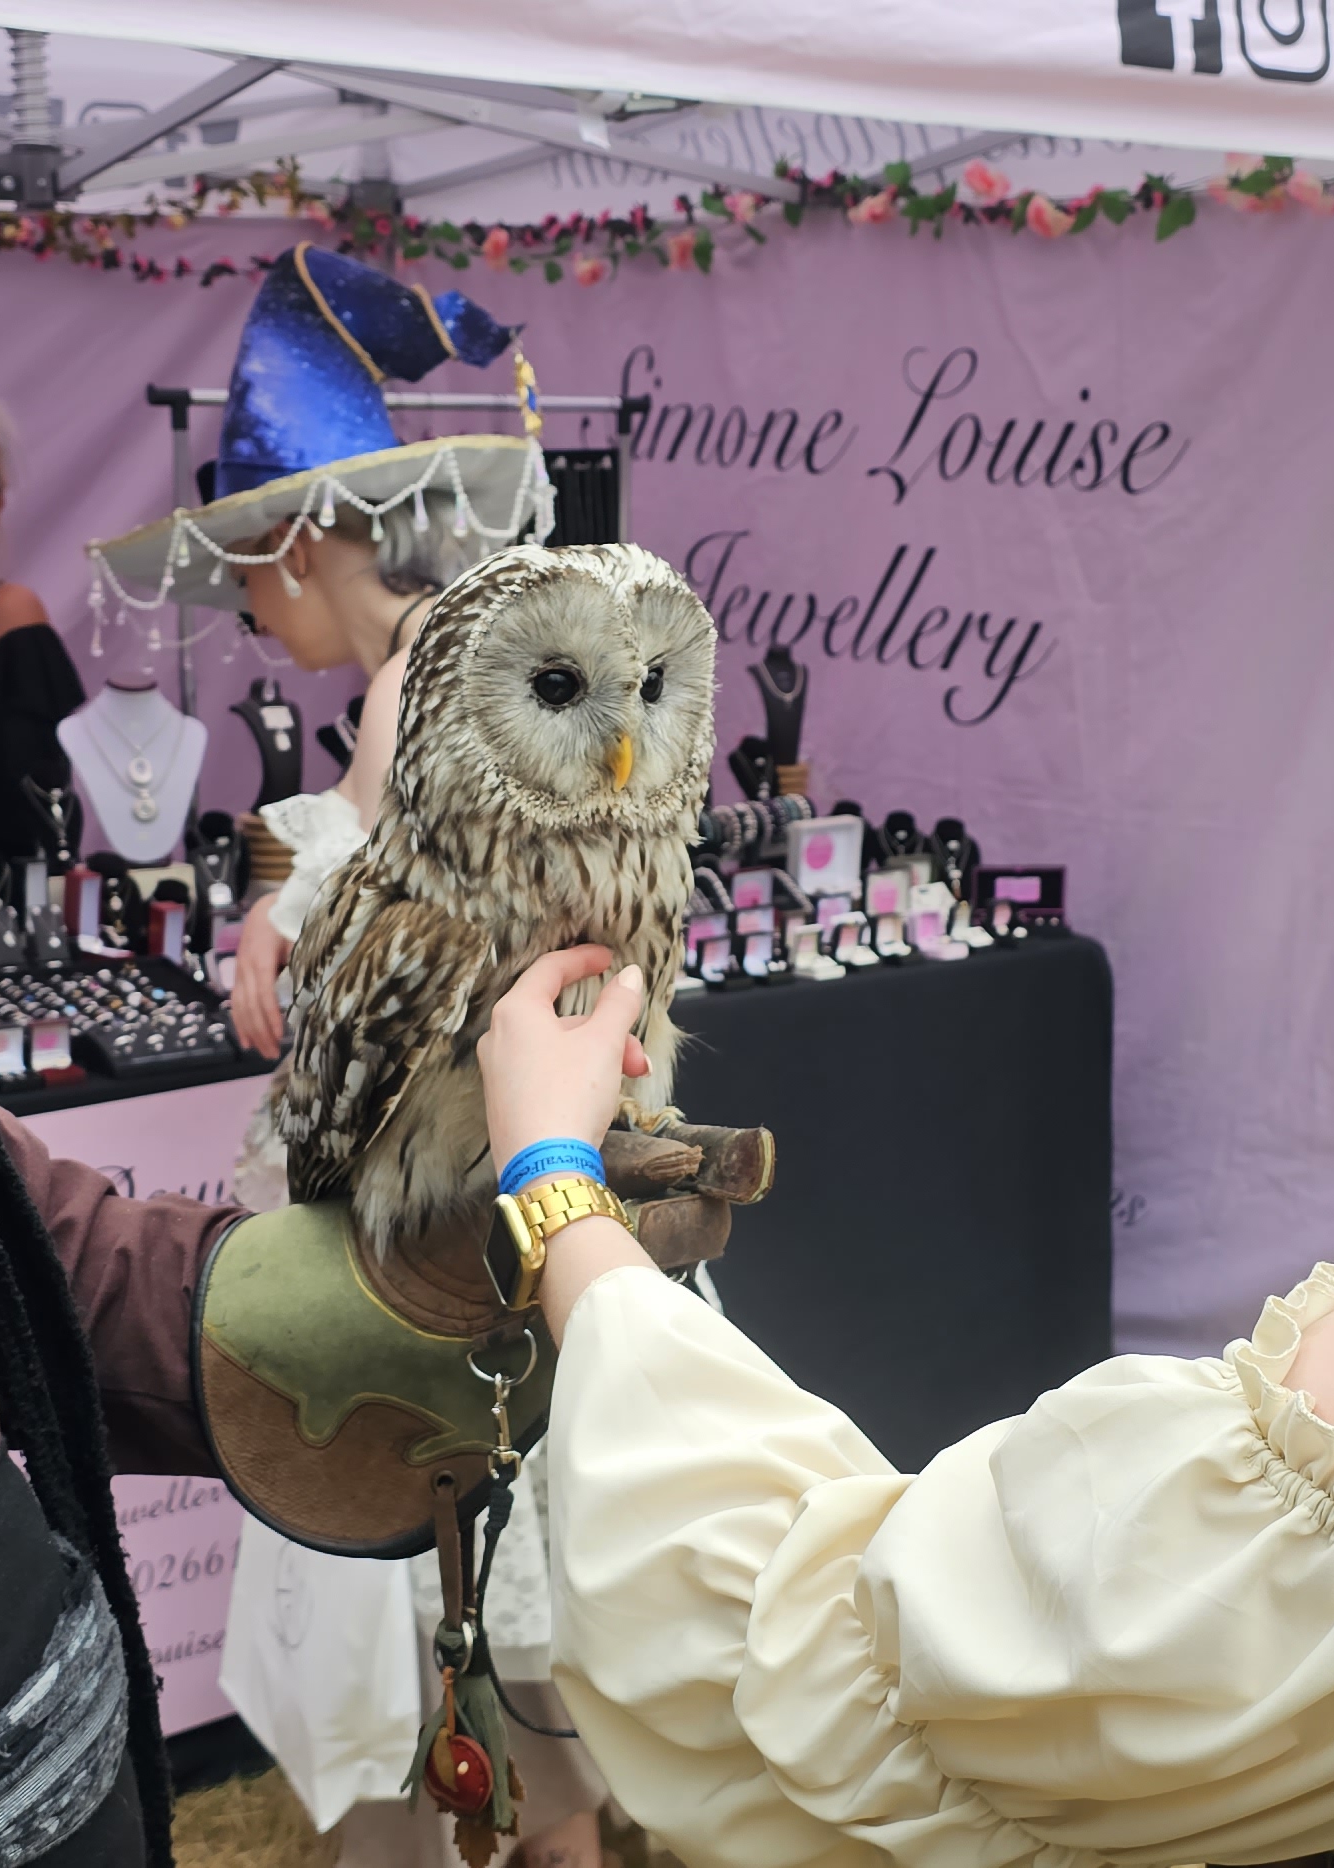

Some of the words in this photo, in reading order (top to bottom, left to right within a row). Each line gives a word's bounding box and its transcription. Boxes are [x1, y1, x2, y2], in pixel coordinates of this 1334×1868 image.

[579, 344, 859, 475] Simone
[867, 346, 1191, 504] Louise
[684, 530, 1058, 728] Jewellery
